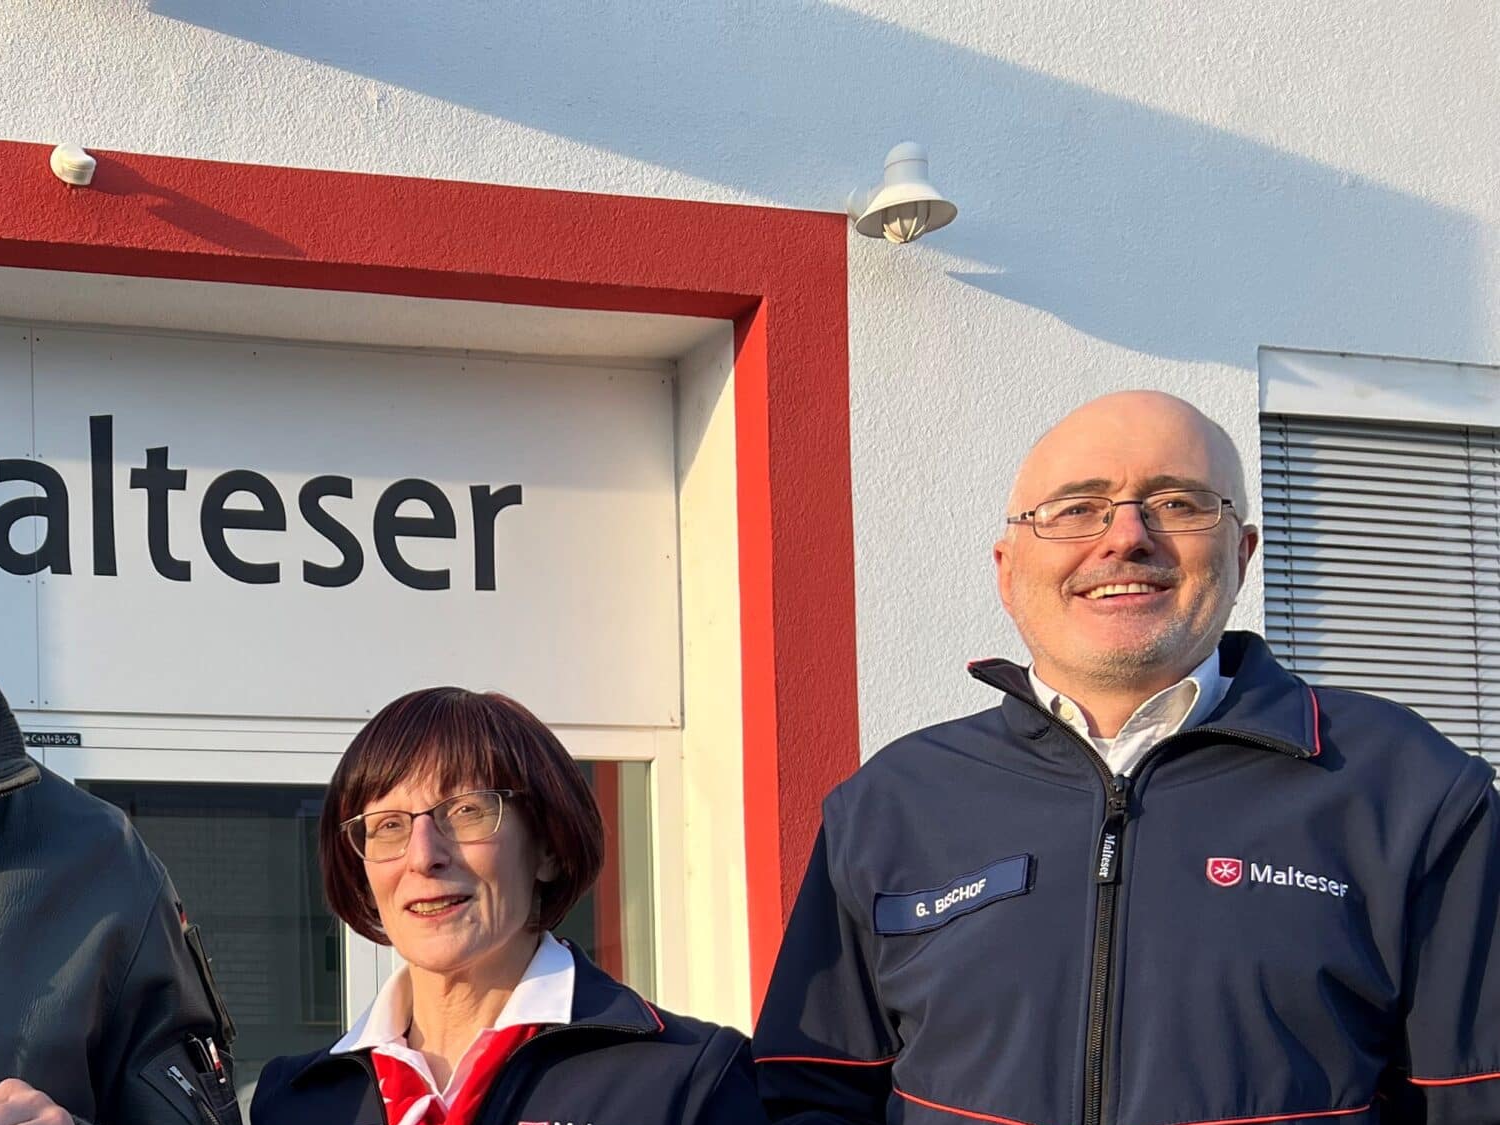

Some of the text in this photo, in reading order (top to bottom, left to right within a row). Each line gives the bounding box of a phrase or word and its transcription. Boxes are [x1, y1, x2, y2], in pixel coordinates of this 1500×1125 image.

[1098, 833, 1117, 878] Malteser
[1250, 863, 1349, 899] Malteser
[916, 902, 931, 917] G.
